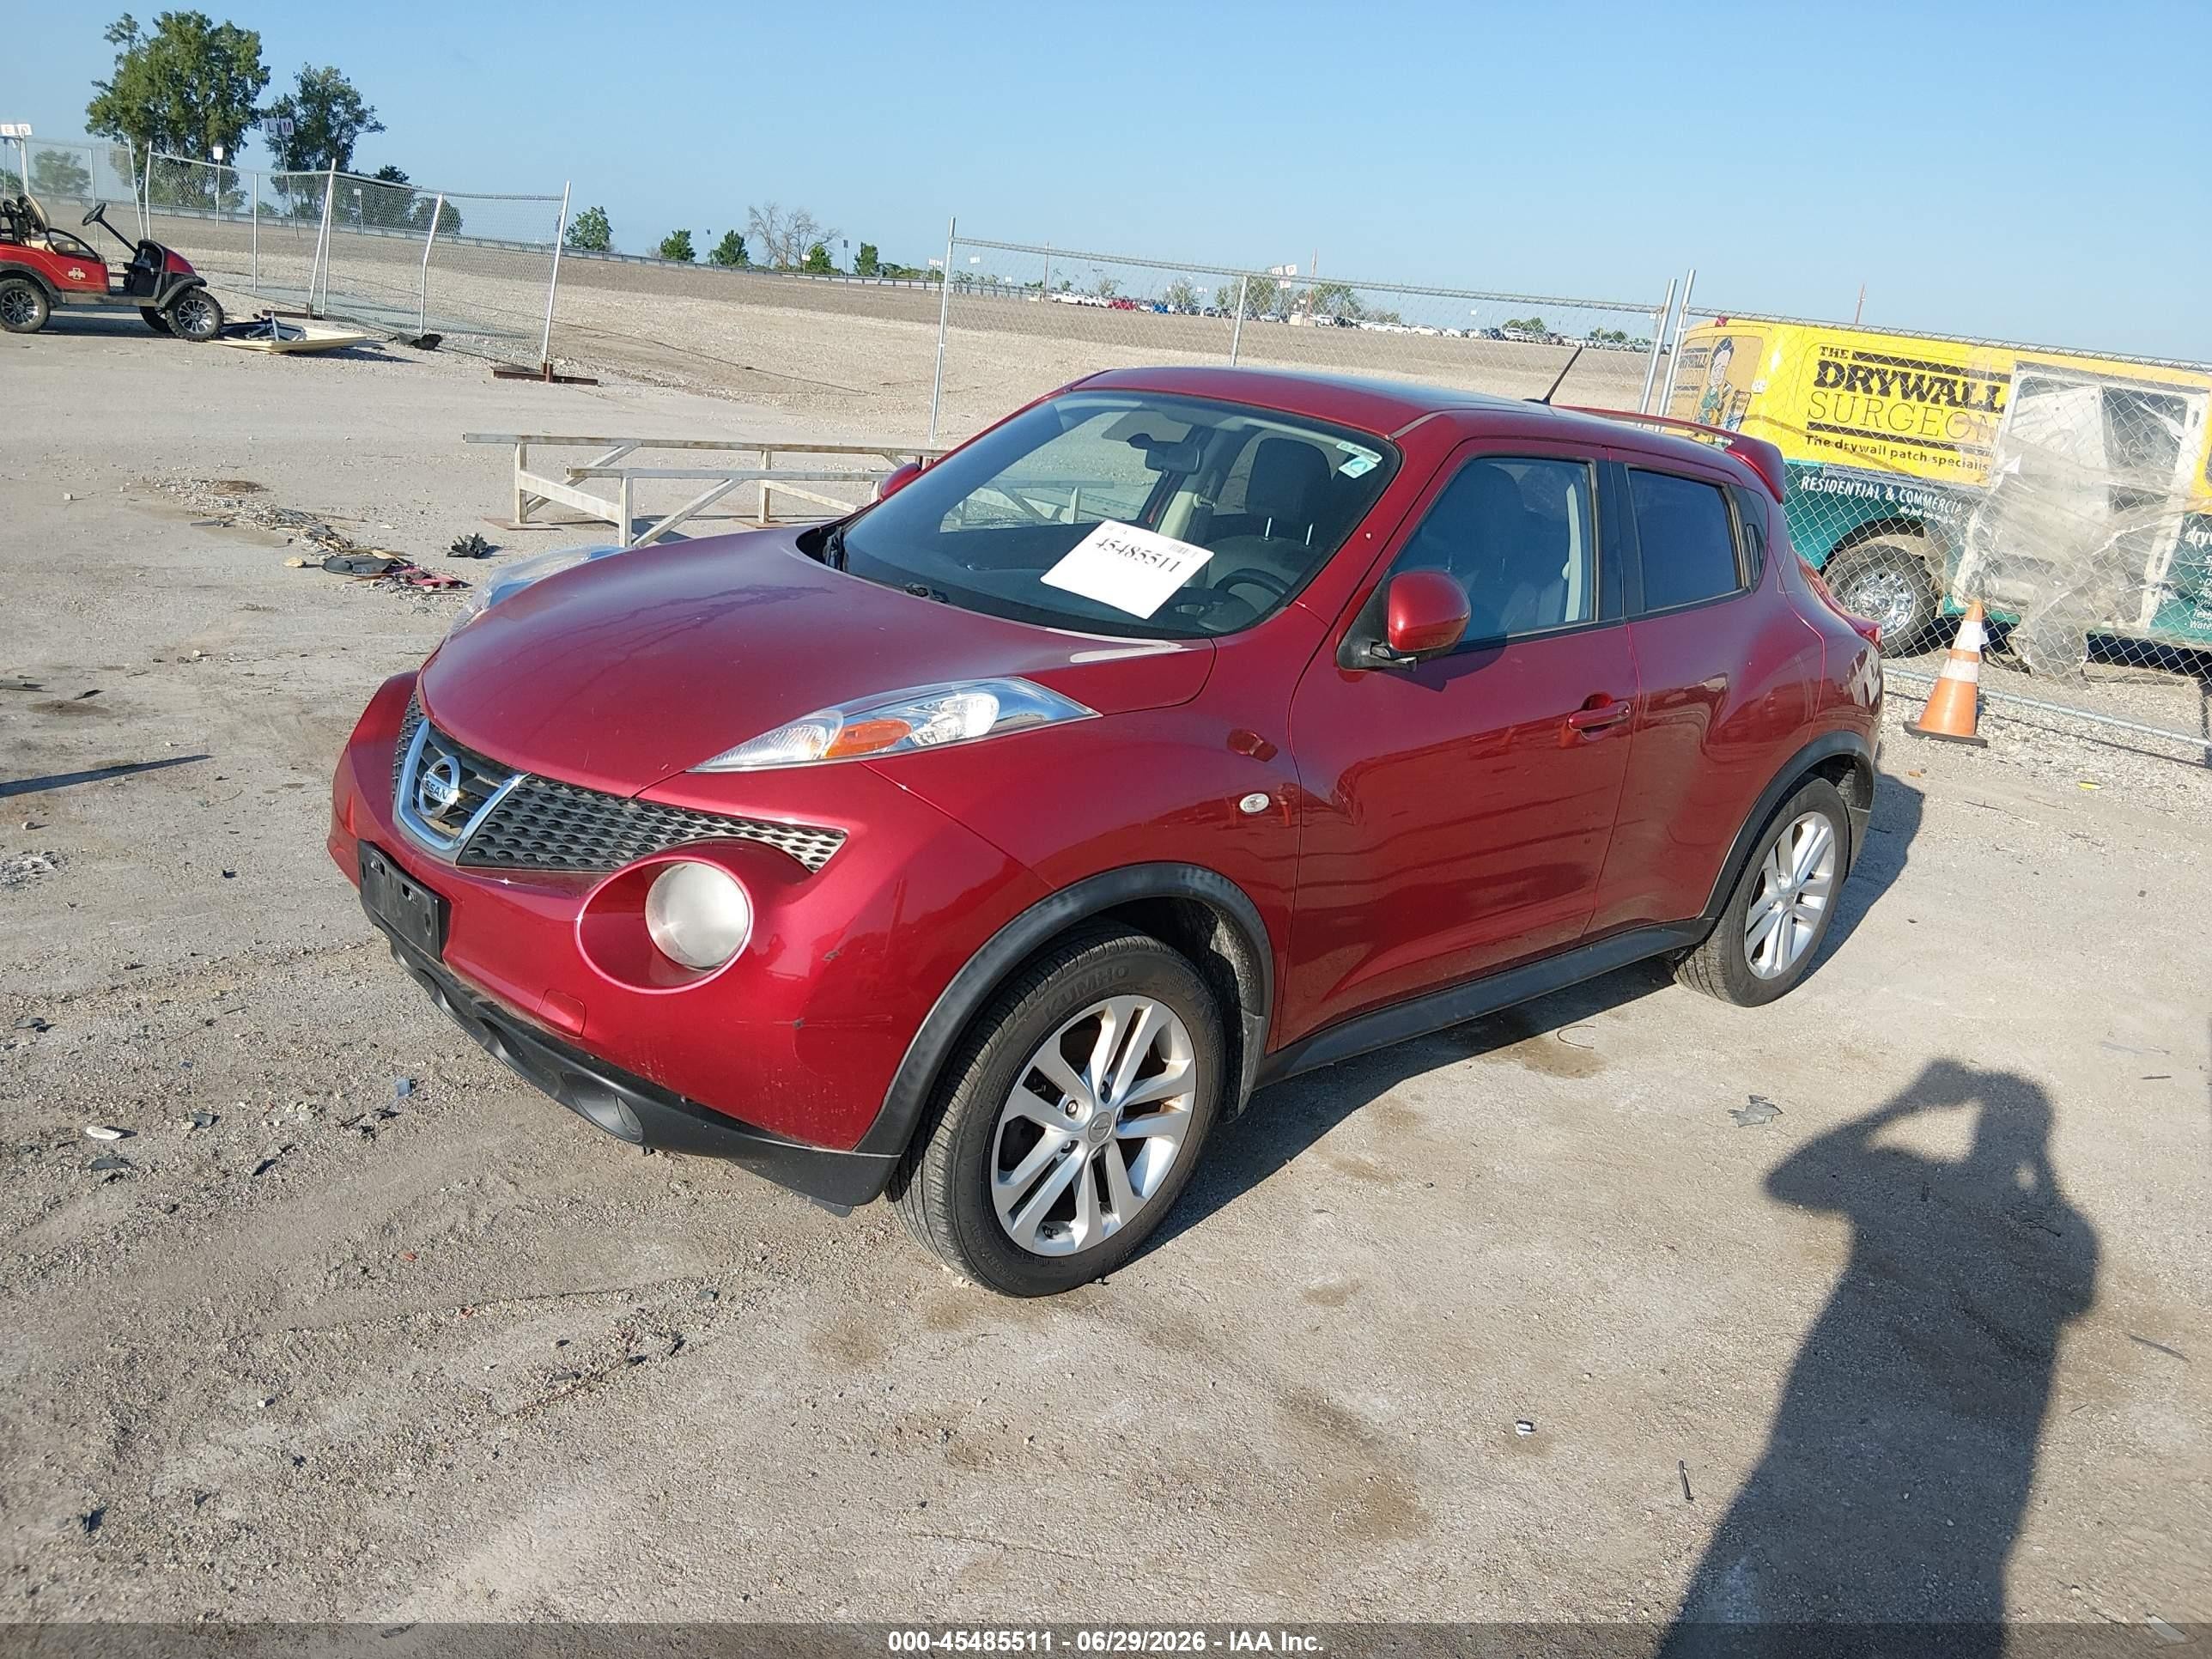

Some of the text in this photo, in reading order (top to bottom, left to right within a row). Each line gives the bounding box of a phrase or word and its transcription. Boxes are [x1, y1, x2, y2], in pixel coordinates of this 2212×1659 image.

[268, 122, 274, 132] L
[283, 122, 292, 132] M
[1819, 346, 1849, 359] THE
[1814, 359, 2007, 414] DRYWALL
[1805, 434, 1990, 472] The drywall patch specialis
[1802, 476, 1963, 514] RESIDENTIAL & COMMERCIA
[1899, 506, 1910, 514] No
[2185, 526, 2212, 550] dry
[1096, 538, 1182, 572] 45485511
